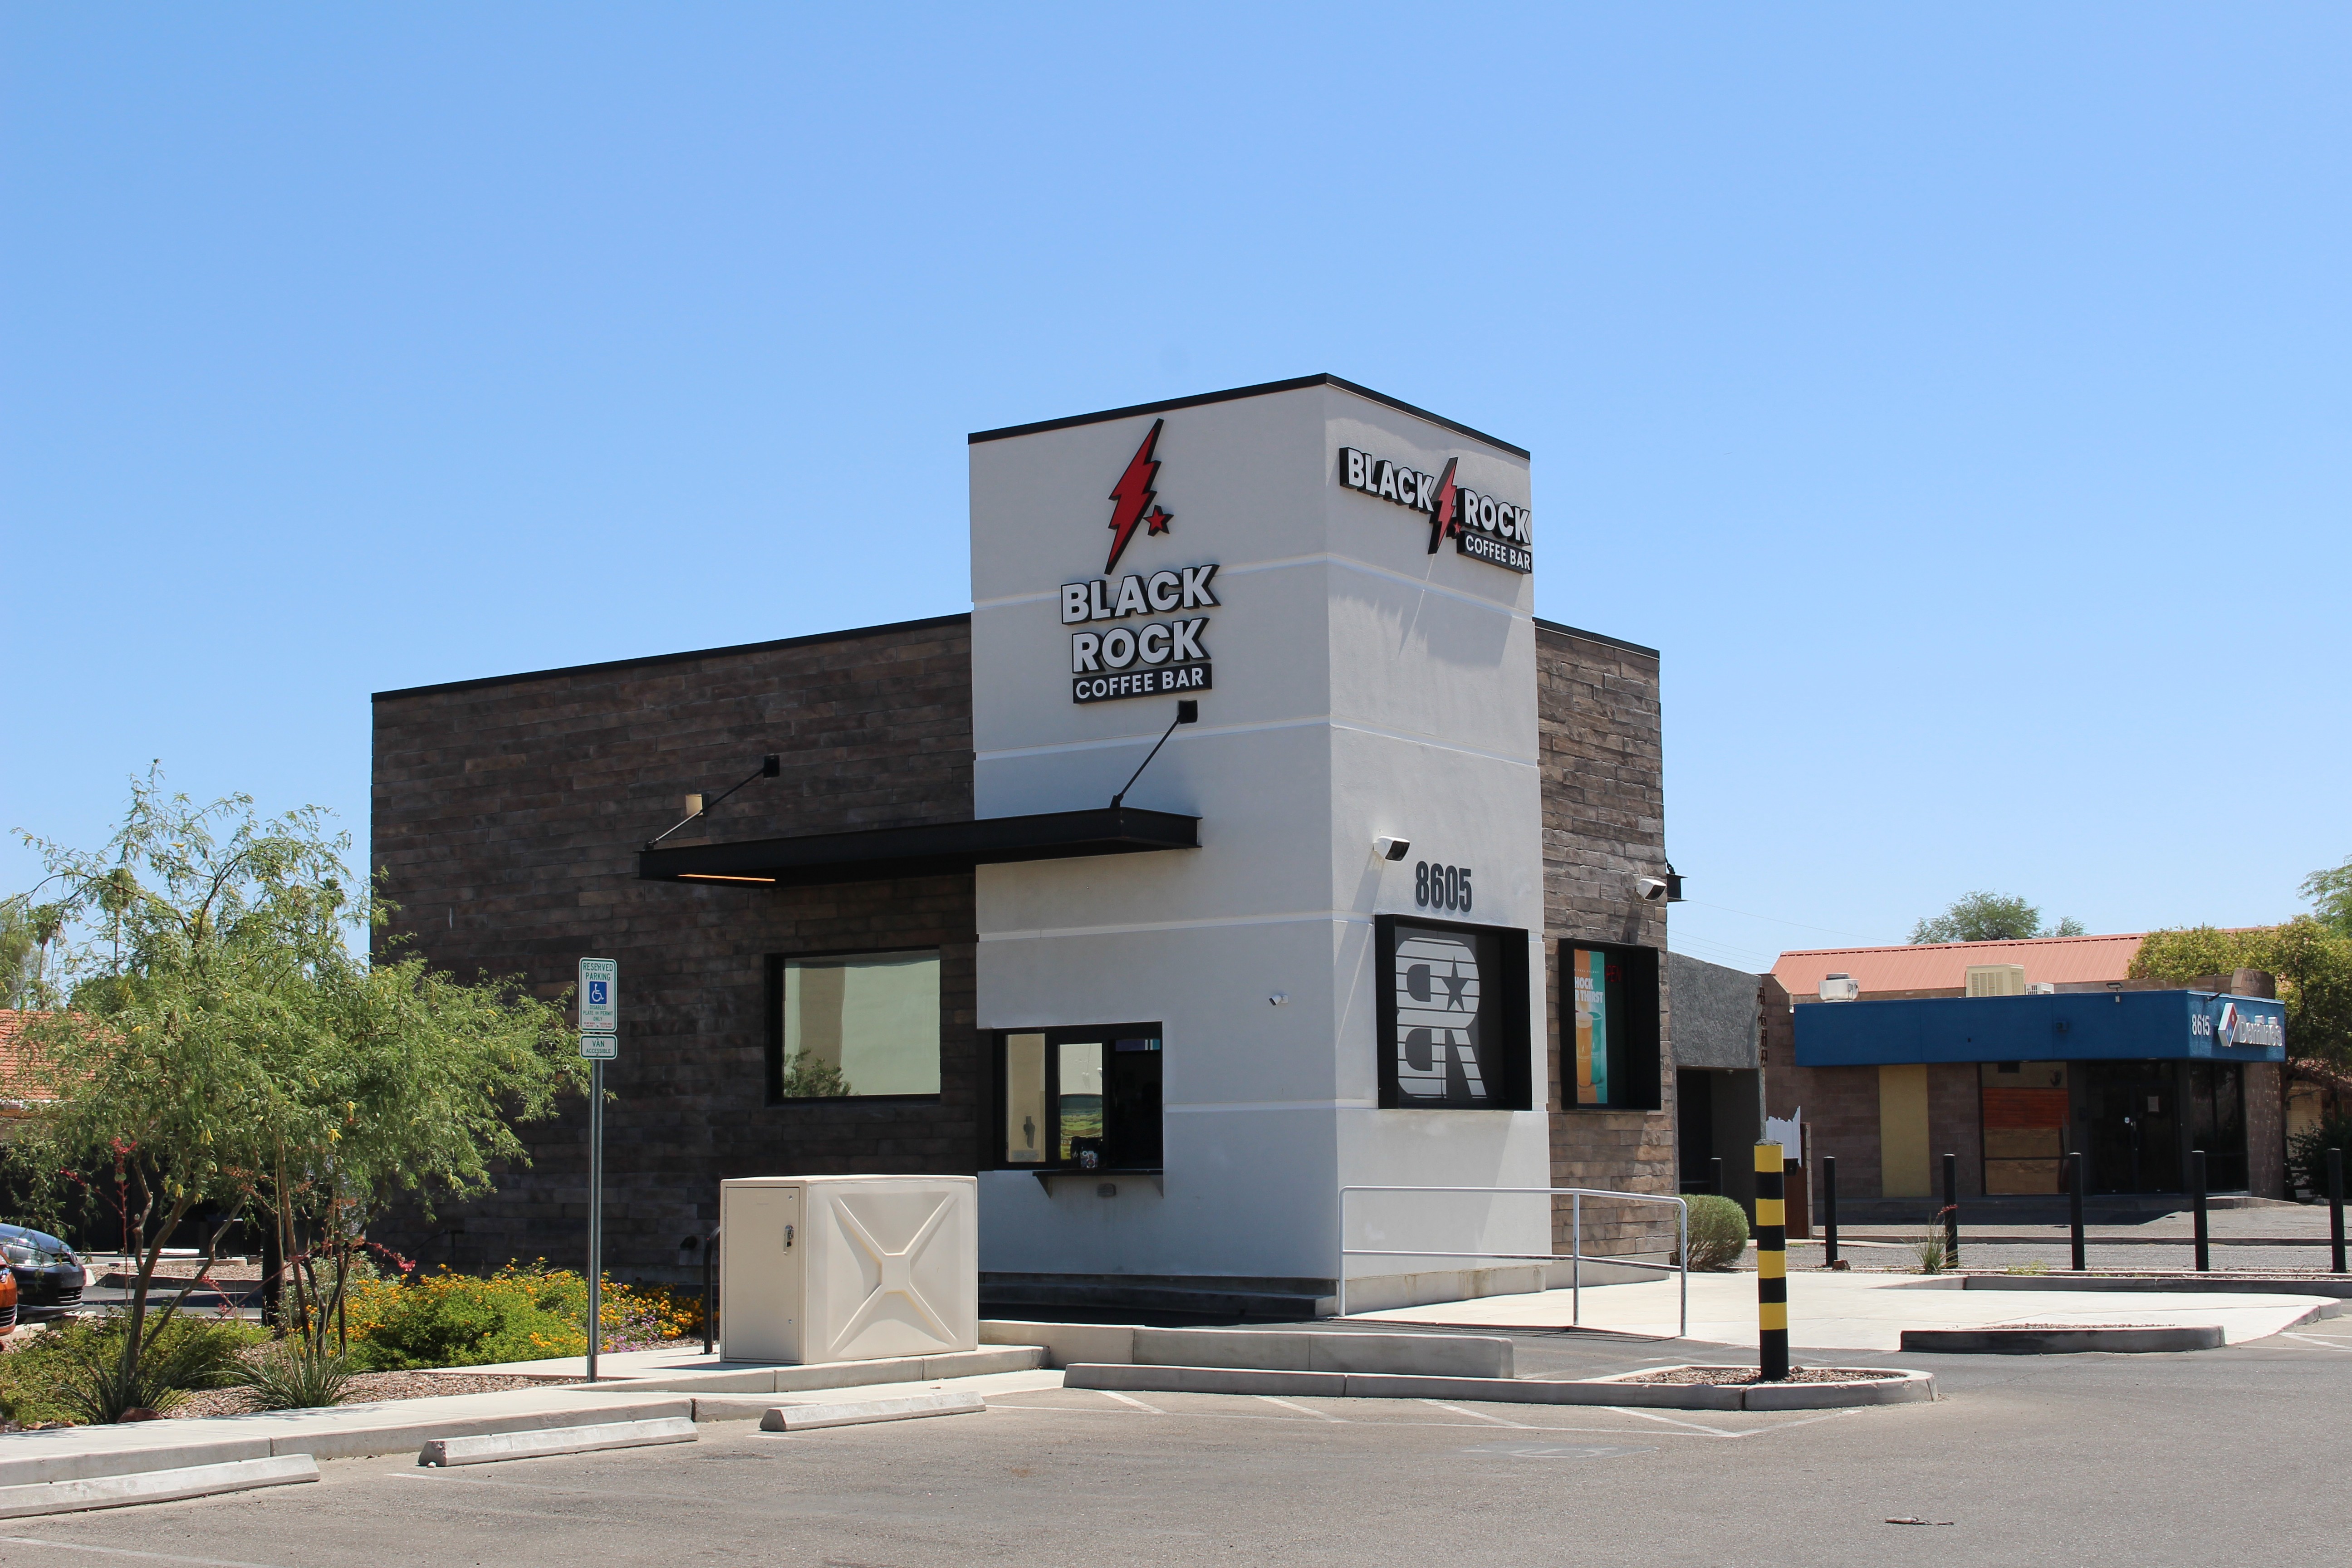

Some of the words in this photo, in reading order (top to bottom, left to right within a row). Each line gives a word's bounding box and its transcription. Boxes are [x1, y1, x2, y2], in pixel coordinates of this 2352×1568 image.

[1340, 447, 1434, 514] BLACK
[1457, 488, 1531, 546] ROCK
[1465, 535, 1506, 563] COFFEE
[1509, 548, 1531, 571] BAR
[1061, 564, 1221, 625] BLACK
[1072, 618, 1211, 674] ROCK
[1076, 672, 1154, 699] COFFEE
[1162, 667, 1204, 690] BAR
[1416, 861, 1472, 912] 8605
[583, 962, 613, 972] RESERVED
[585, 972, 611, 981] PARKING
[1580, 990, 1603, 1003] THIRST
[2192, 1014, 2210, 1036] 8615
